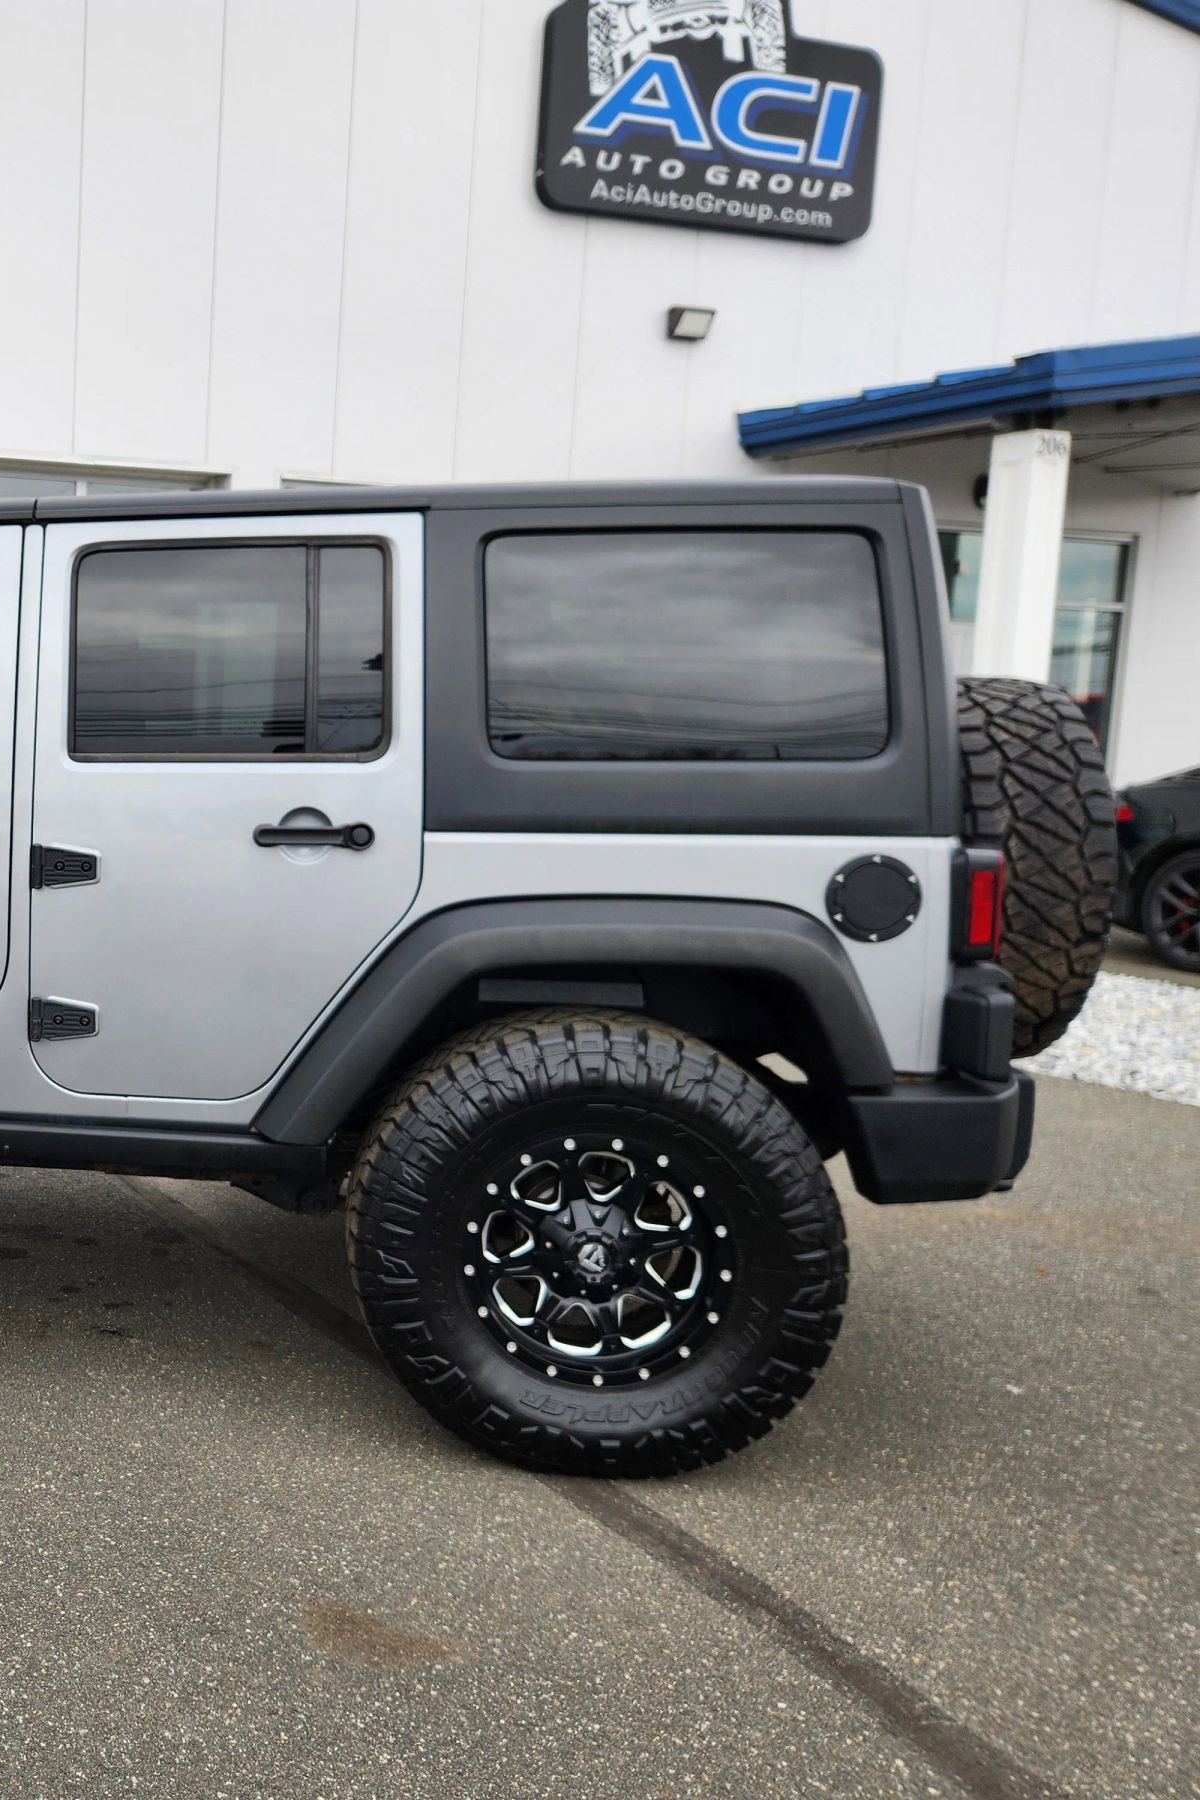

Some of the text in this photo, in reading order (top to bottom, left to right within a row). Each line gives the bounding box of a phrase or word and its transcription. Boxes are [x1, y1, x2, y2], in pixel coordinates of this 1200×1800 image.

[574, 52, 862, 171] ACI
[560, 146, 855, 202] AUTO GROUP
[590, 178, 833, 229] AciAutoGroup.com
